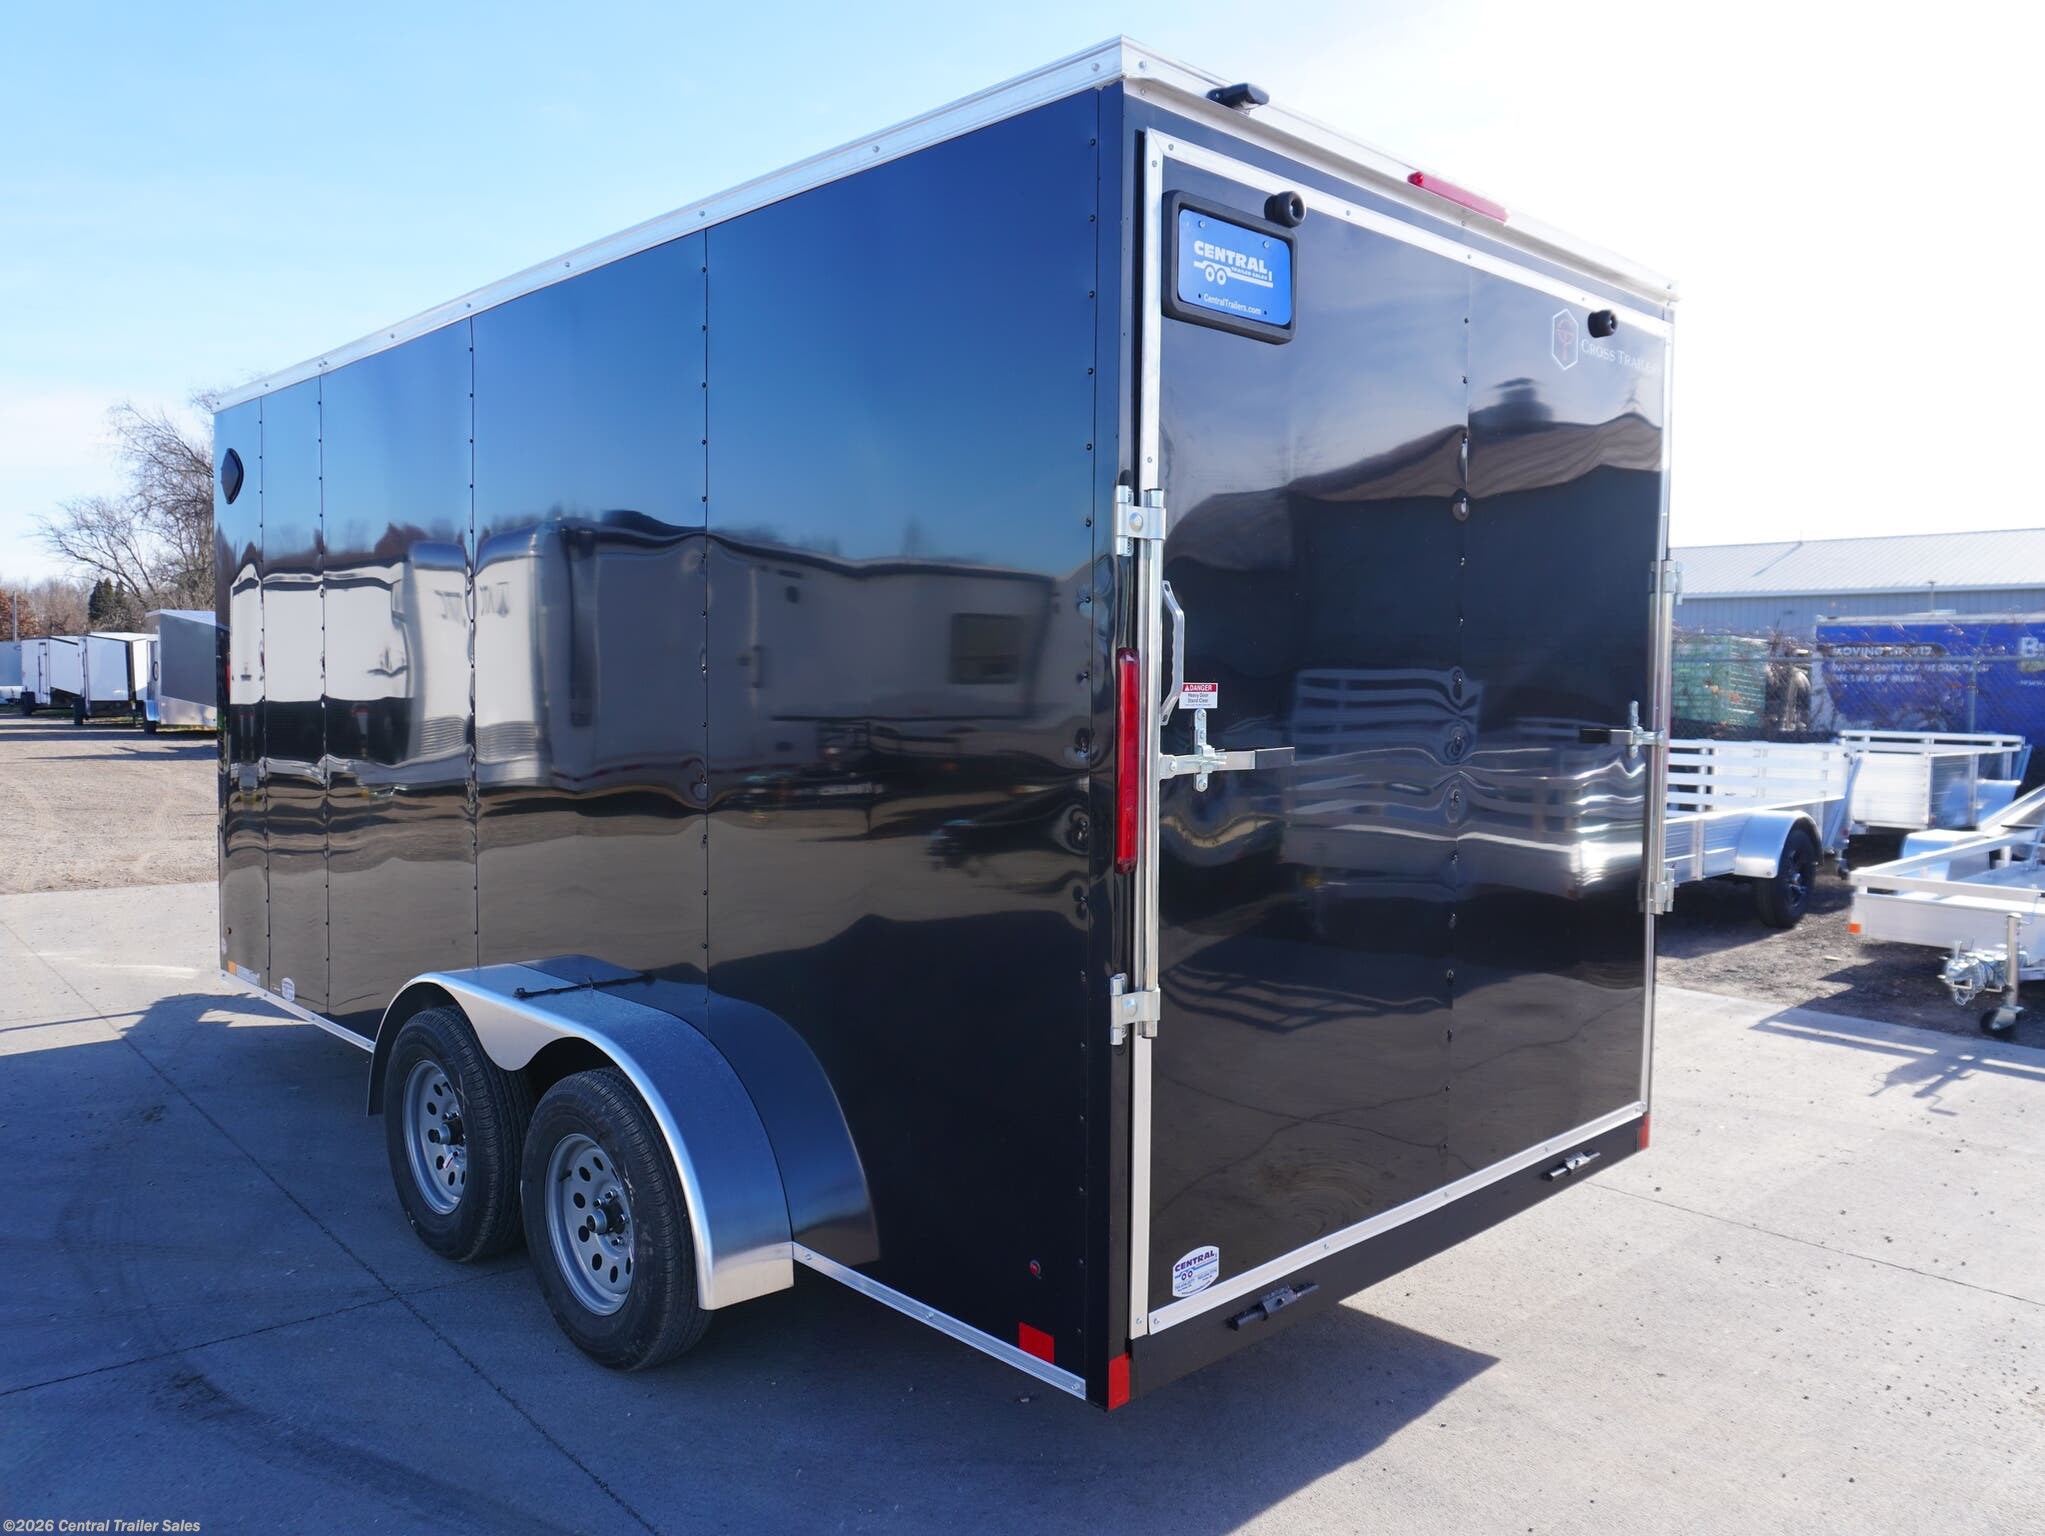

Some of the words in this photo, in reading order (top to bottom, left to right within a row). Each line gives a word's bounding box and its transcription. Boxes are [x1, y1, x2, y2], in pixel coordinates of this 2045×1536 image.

[1193, 240, 1268, 274] CENTRAL
[1203, 293, 1262, 315] CentralTrailers.com
[1581, 338, 1616, 361] CROSS
[1189, 684, 1213, 692] DANGER
[1175, 1250, 1215, 1272] CENTRAL
